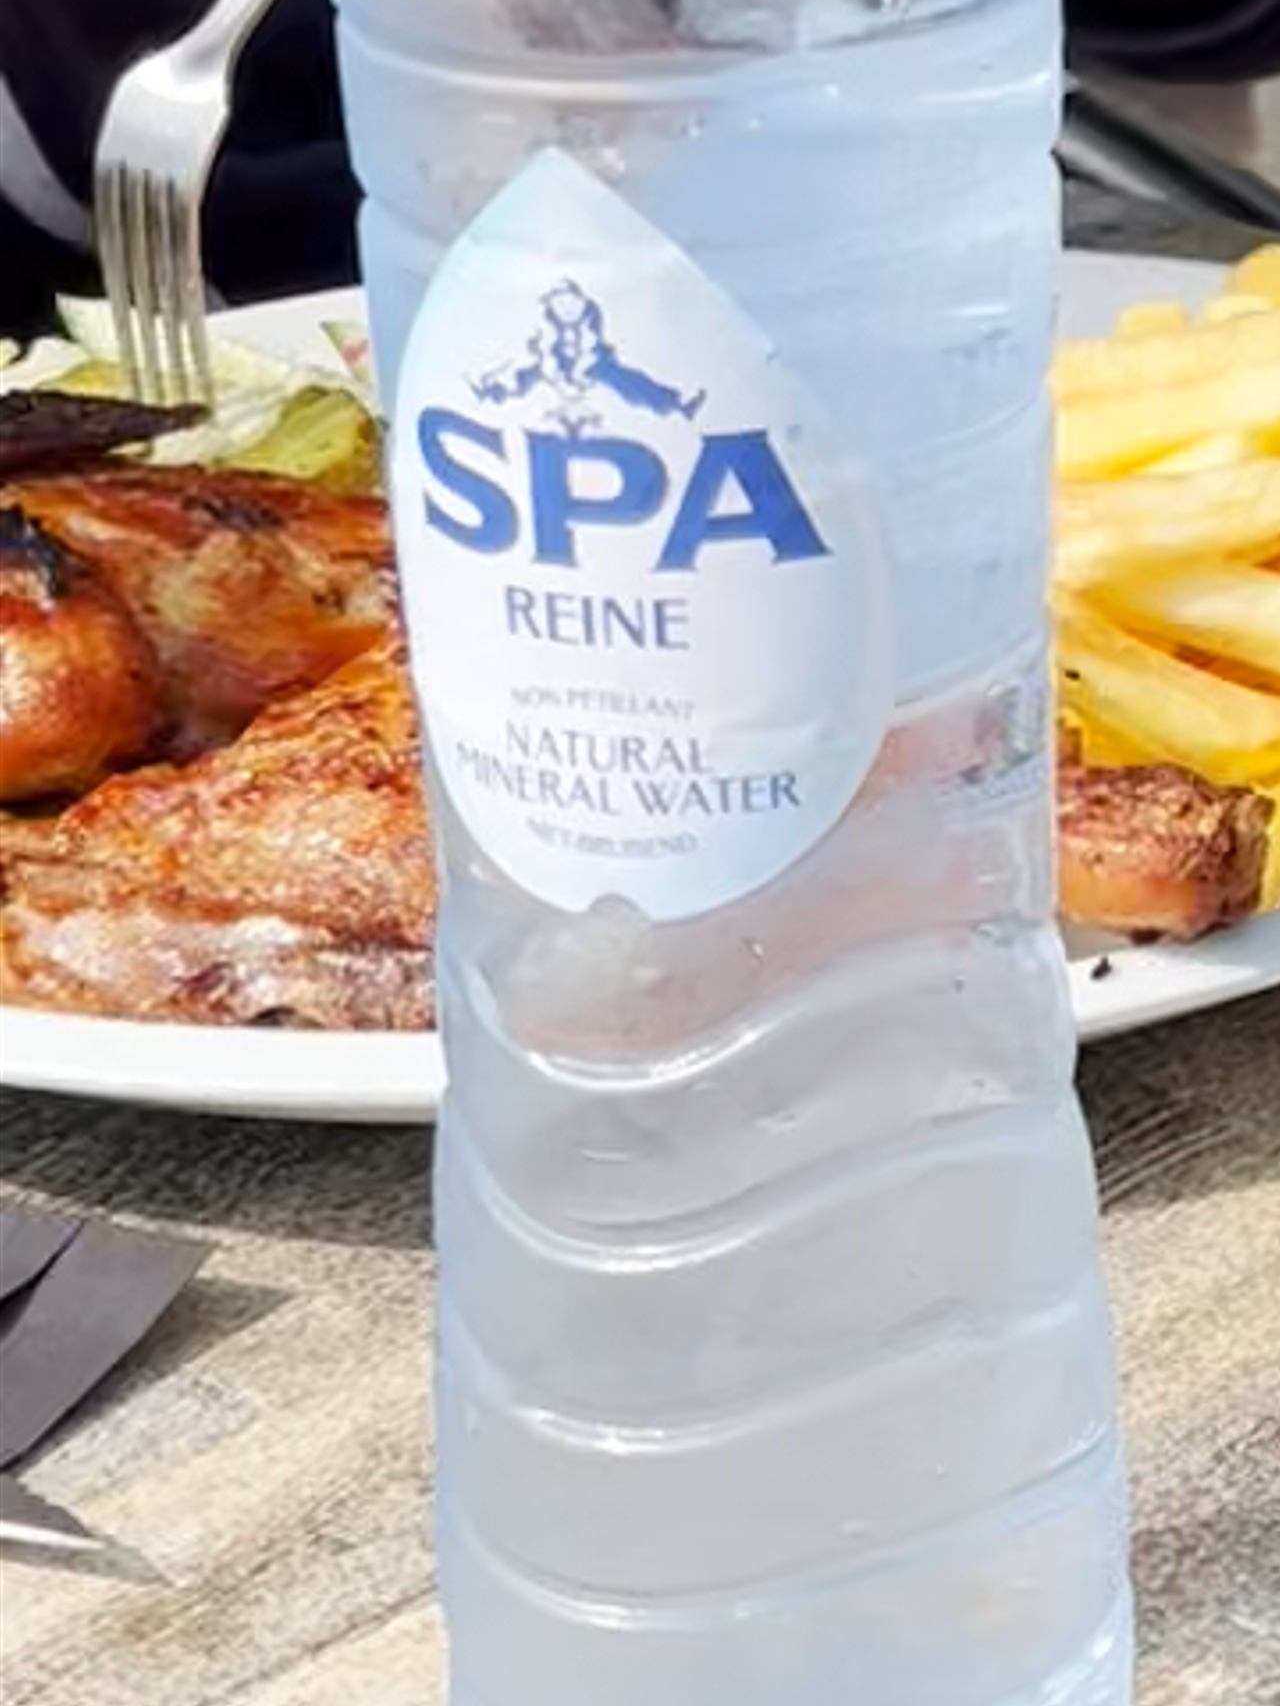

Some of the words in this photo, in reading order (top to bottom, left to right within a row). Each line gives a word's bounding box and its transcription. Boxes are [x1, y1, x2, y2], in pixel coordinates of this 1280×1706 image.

[417, 406, 834, 573] SPA
[503, 584, 691, 650] REINE
[456, 740, 621, 816] MINERAL
[632, 769, 802, 817] WATER
[506, 718, 712, 775] NATURAL
